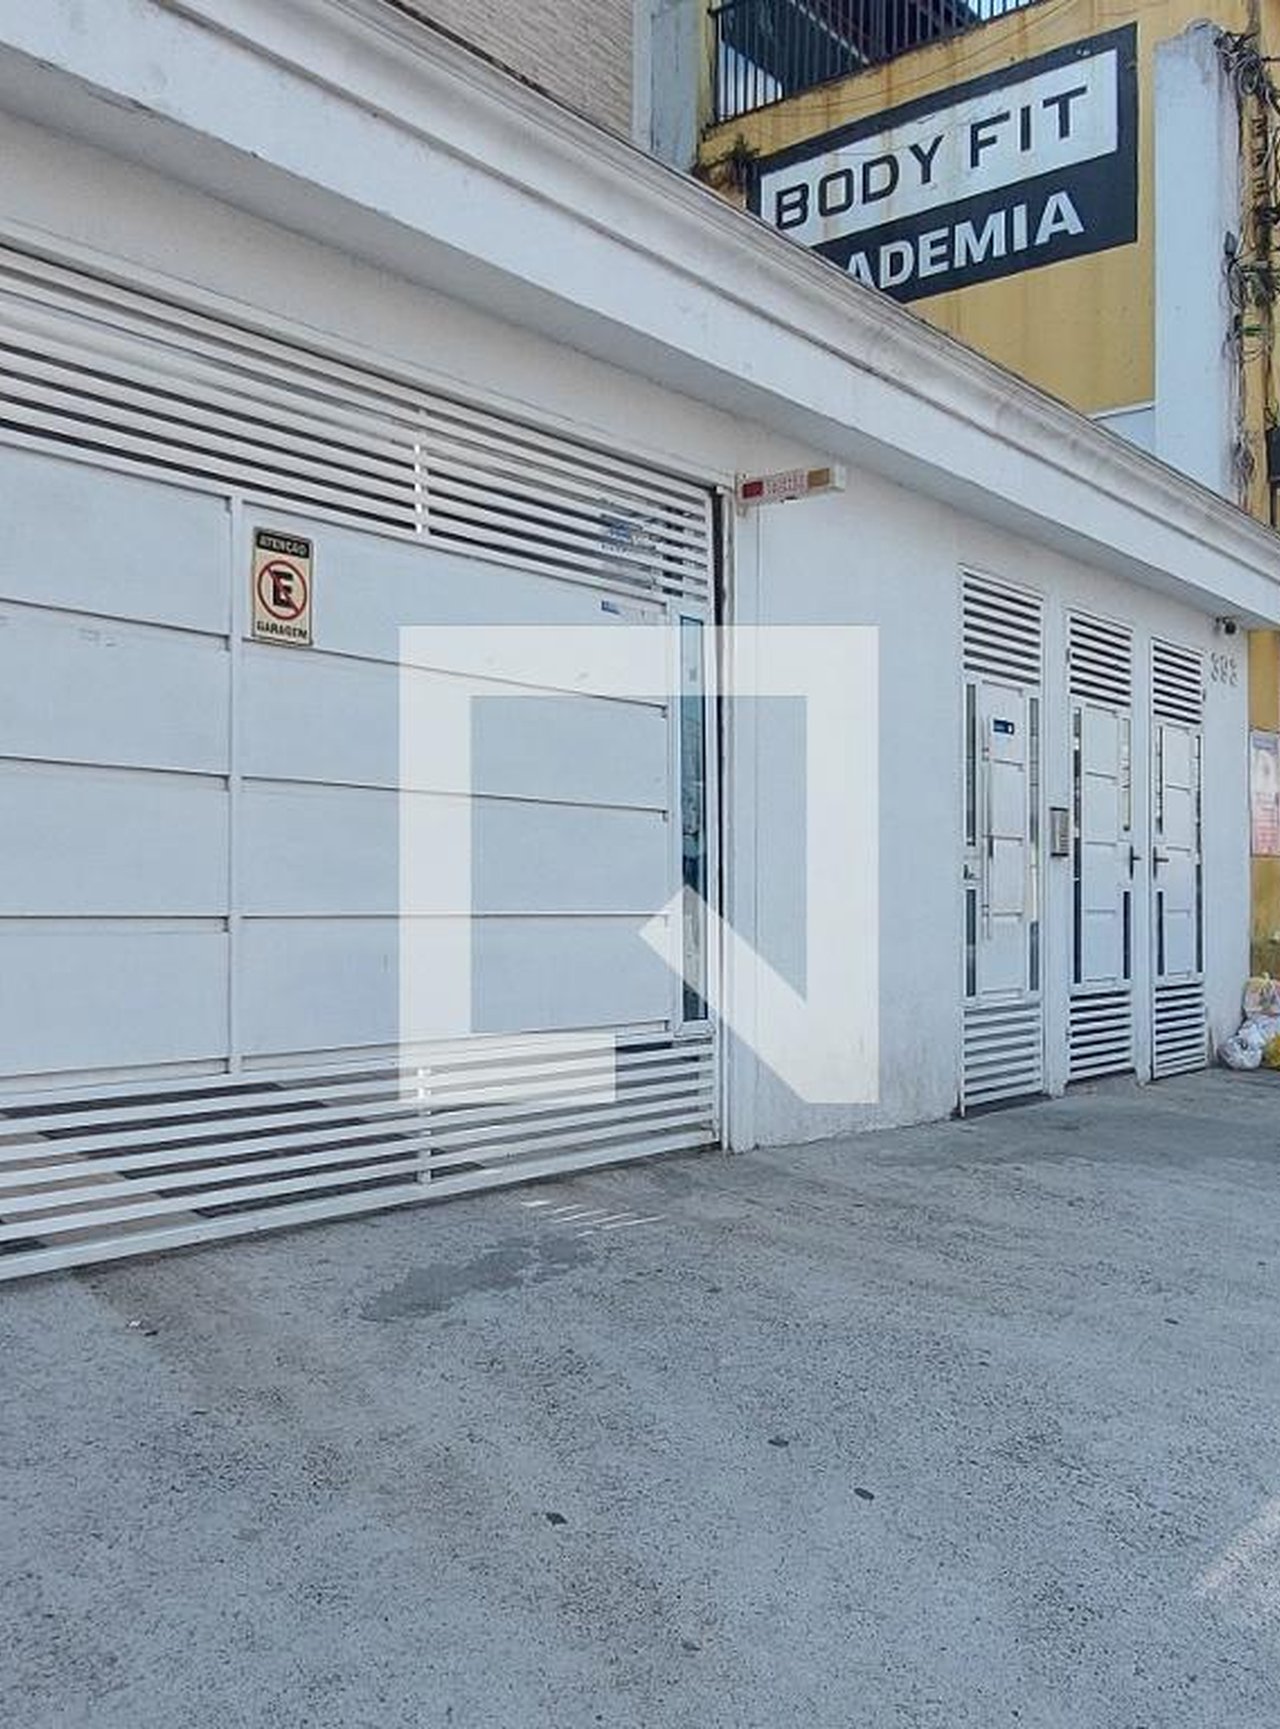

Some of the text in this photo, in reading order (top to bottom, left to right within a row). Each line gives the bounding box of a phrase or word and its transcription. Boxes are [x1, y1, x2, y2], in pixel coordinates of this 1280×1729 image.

[776, 86, 1088, 230] BODY FIT
[846, 191, 1085, 290] ADEMIA
[257, 620, 308, 639] GARAGEM
